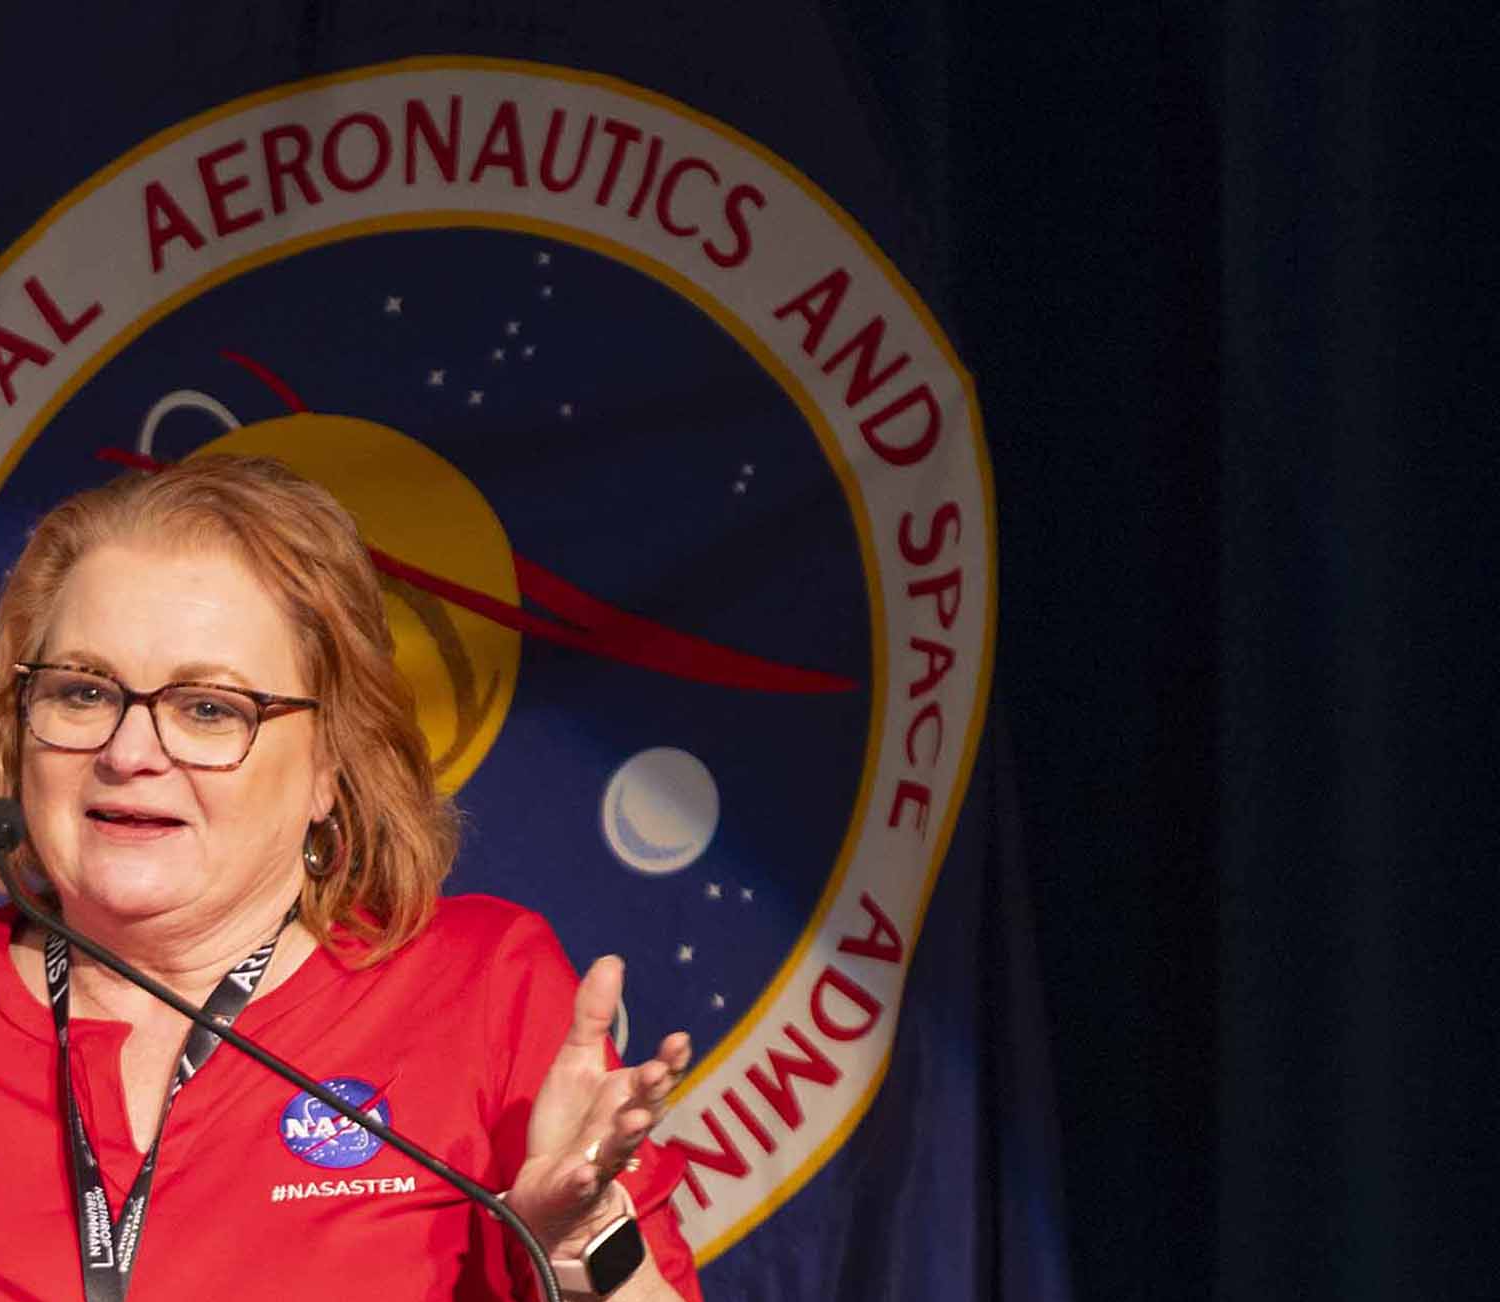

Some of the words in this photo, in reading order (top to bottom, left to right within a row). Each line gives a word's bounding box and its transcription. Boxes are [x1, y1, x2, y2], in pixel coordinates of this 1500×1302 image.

[142, 95, 767, 273] AERONAUTICS
[772, 267, 943, 467] AND
[888, 502, 962, 842] SPACE
[286, 1108, 385, 1141] NASA
[94, 1185, 113, 1248] NORTHROP
[271, 1175, 416, 1203] #NASASTEM
[84, 1191, 103, 1257] GRUMMAN
